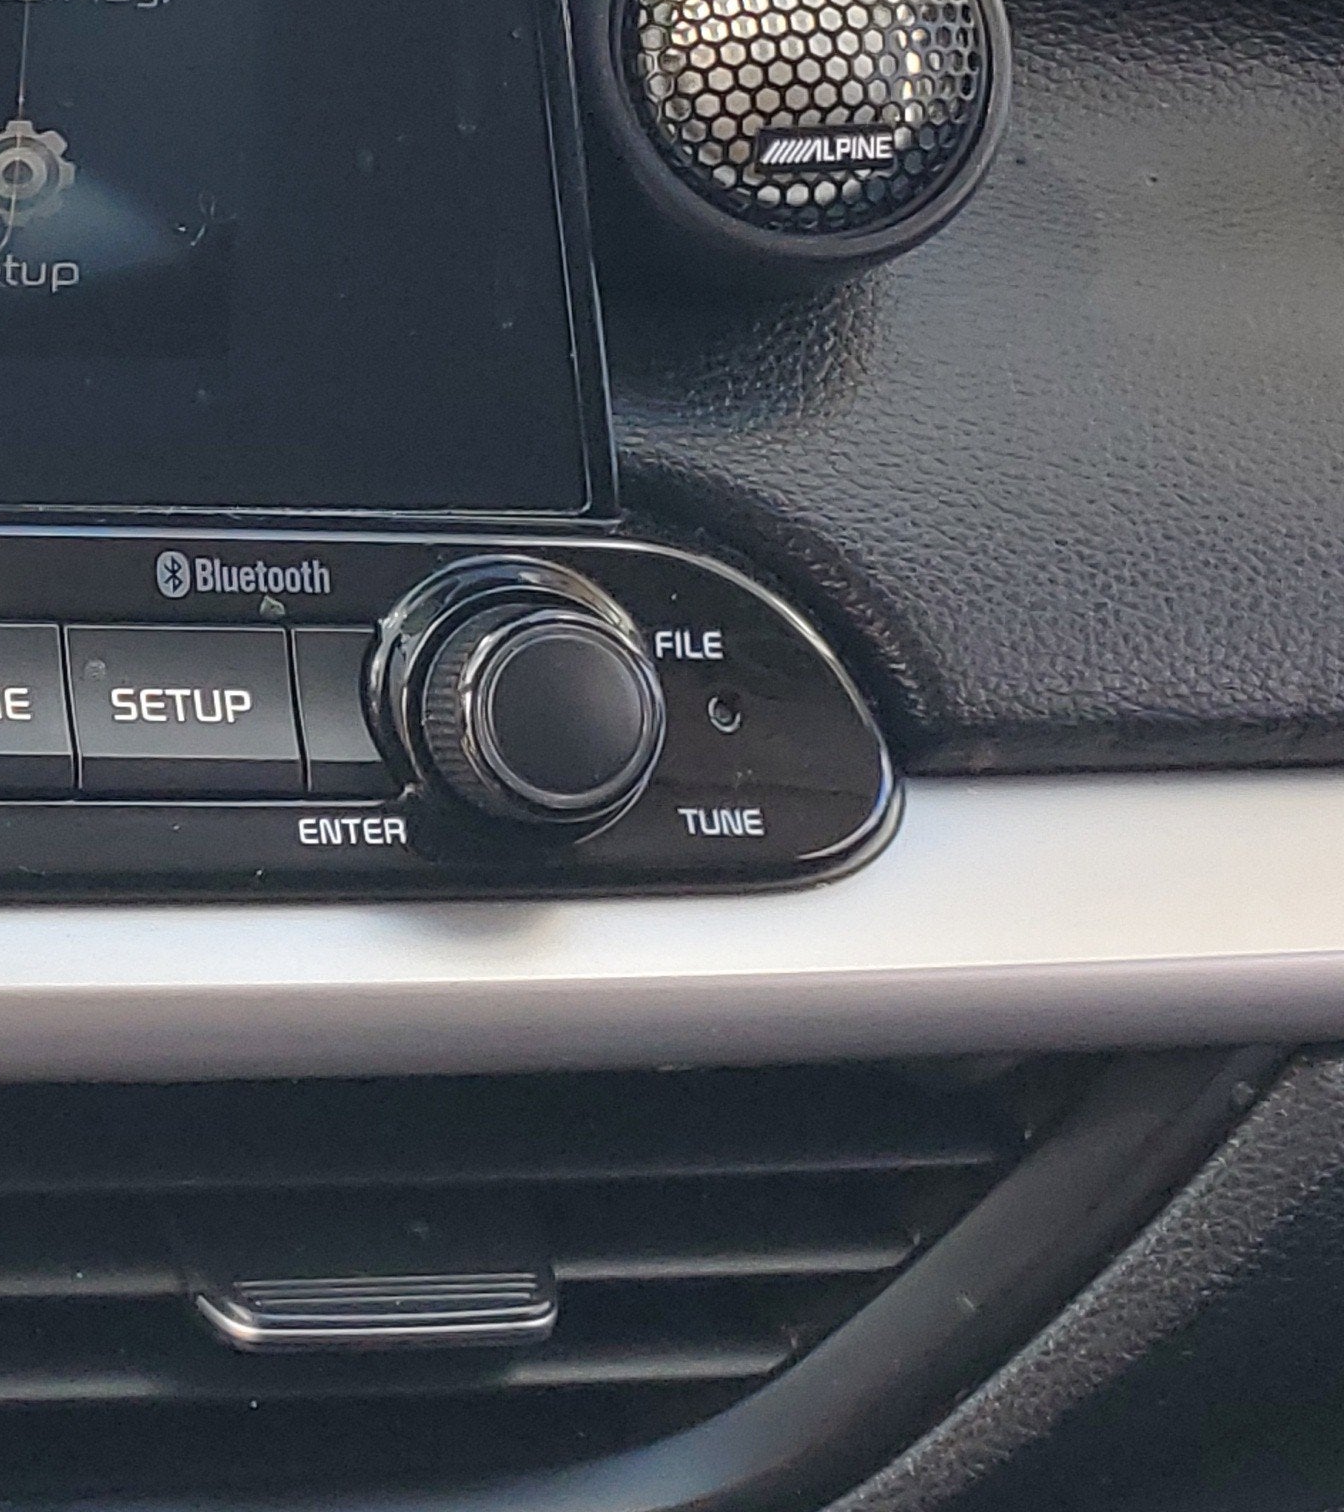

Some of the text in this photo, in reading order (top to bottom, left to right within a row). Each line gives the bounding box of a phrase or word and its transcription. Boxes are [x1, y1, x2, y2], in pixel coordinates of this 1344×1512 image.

[801, 135, 894, 164] ALPINE
[195, 553, 332, 595] Bluetooth
[655, 631, 724, 660] FILE
[110, 687, 253, 724] SETUP
[298, 816, 407, 847] ENTER
[677, 807, 765, 837] TUNE
